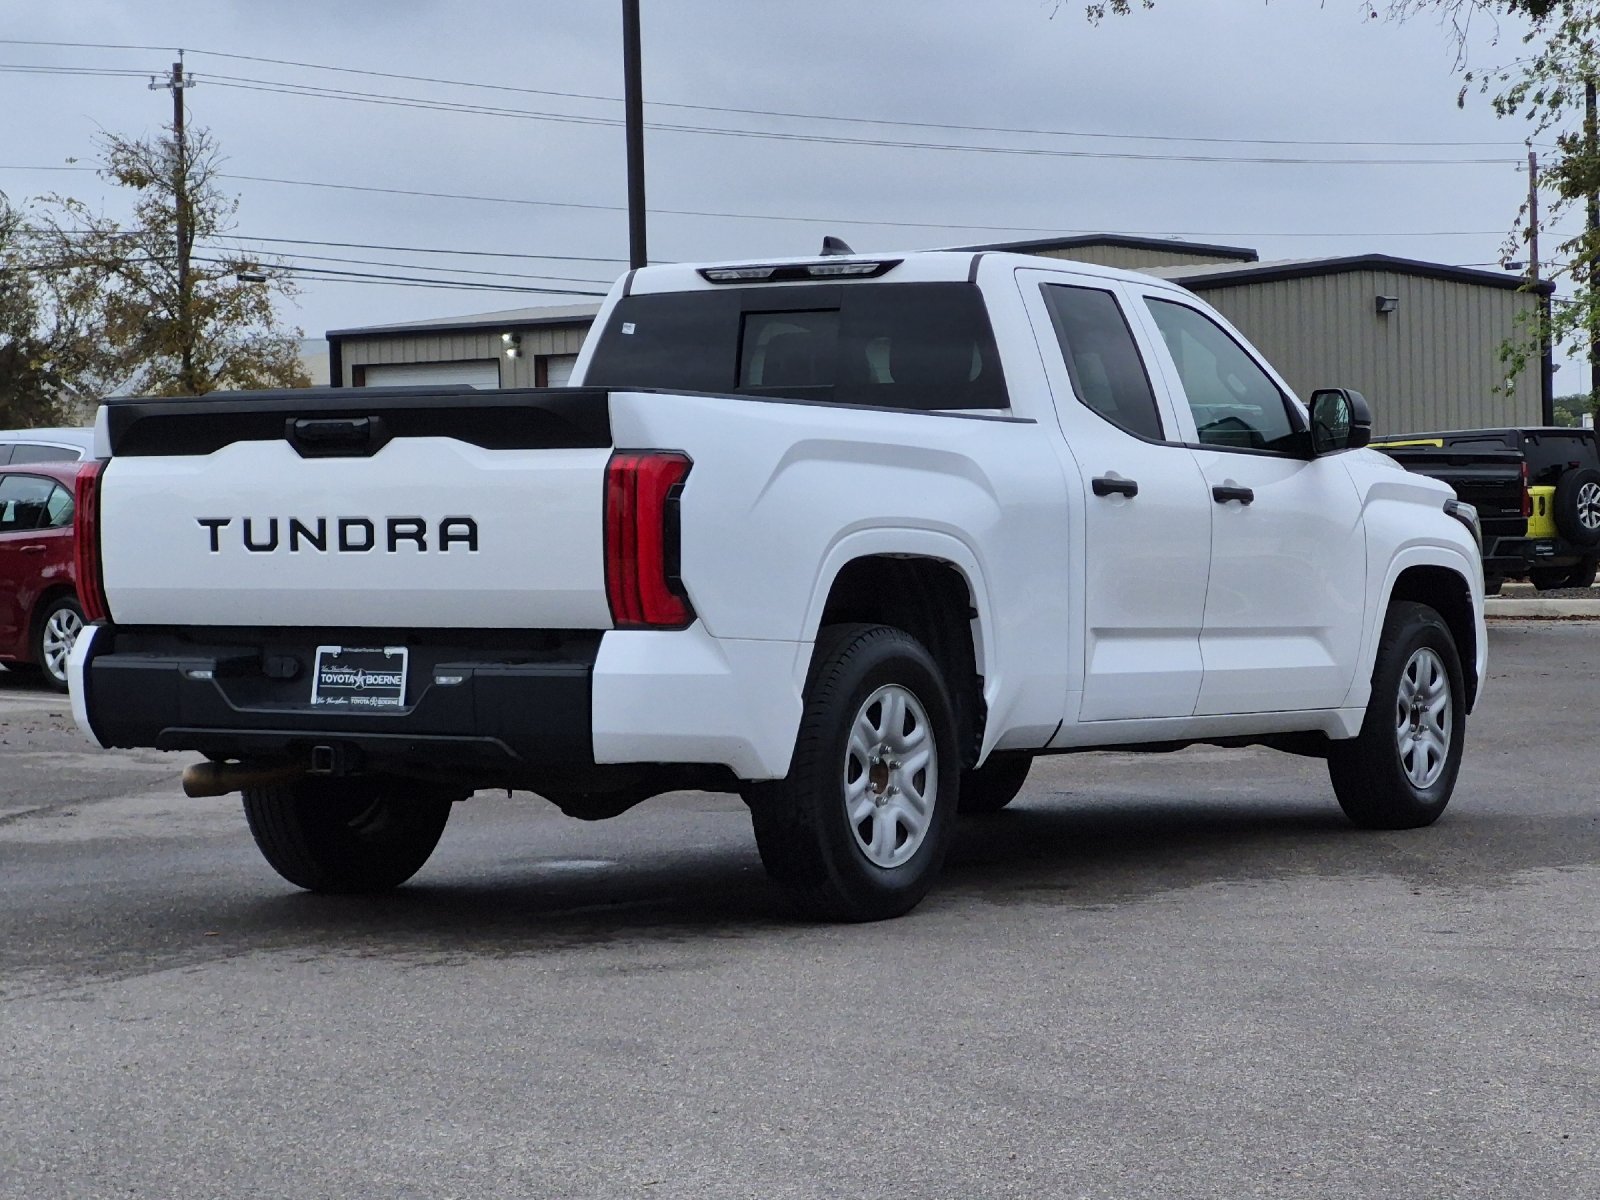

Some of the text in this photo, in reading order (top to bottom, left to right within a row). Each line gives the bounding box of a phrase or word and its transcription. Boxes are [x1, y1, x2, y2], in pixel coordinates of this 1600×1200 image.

[196, 516, 479, 553] TUNDRA
[321, 673, 402, 685] TOYOTA BOERNE
